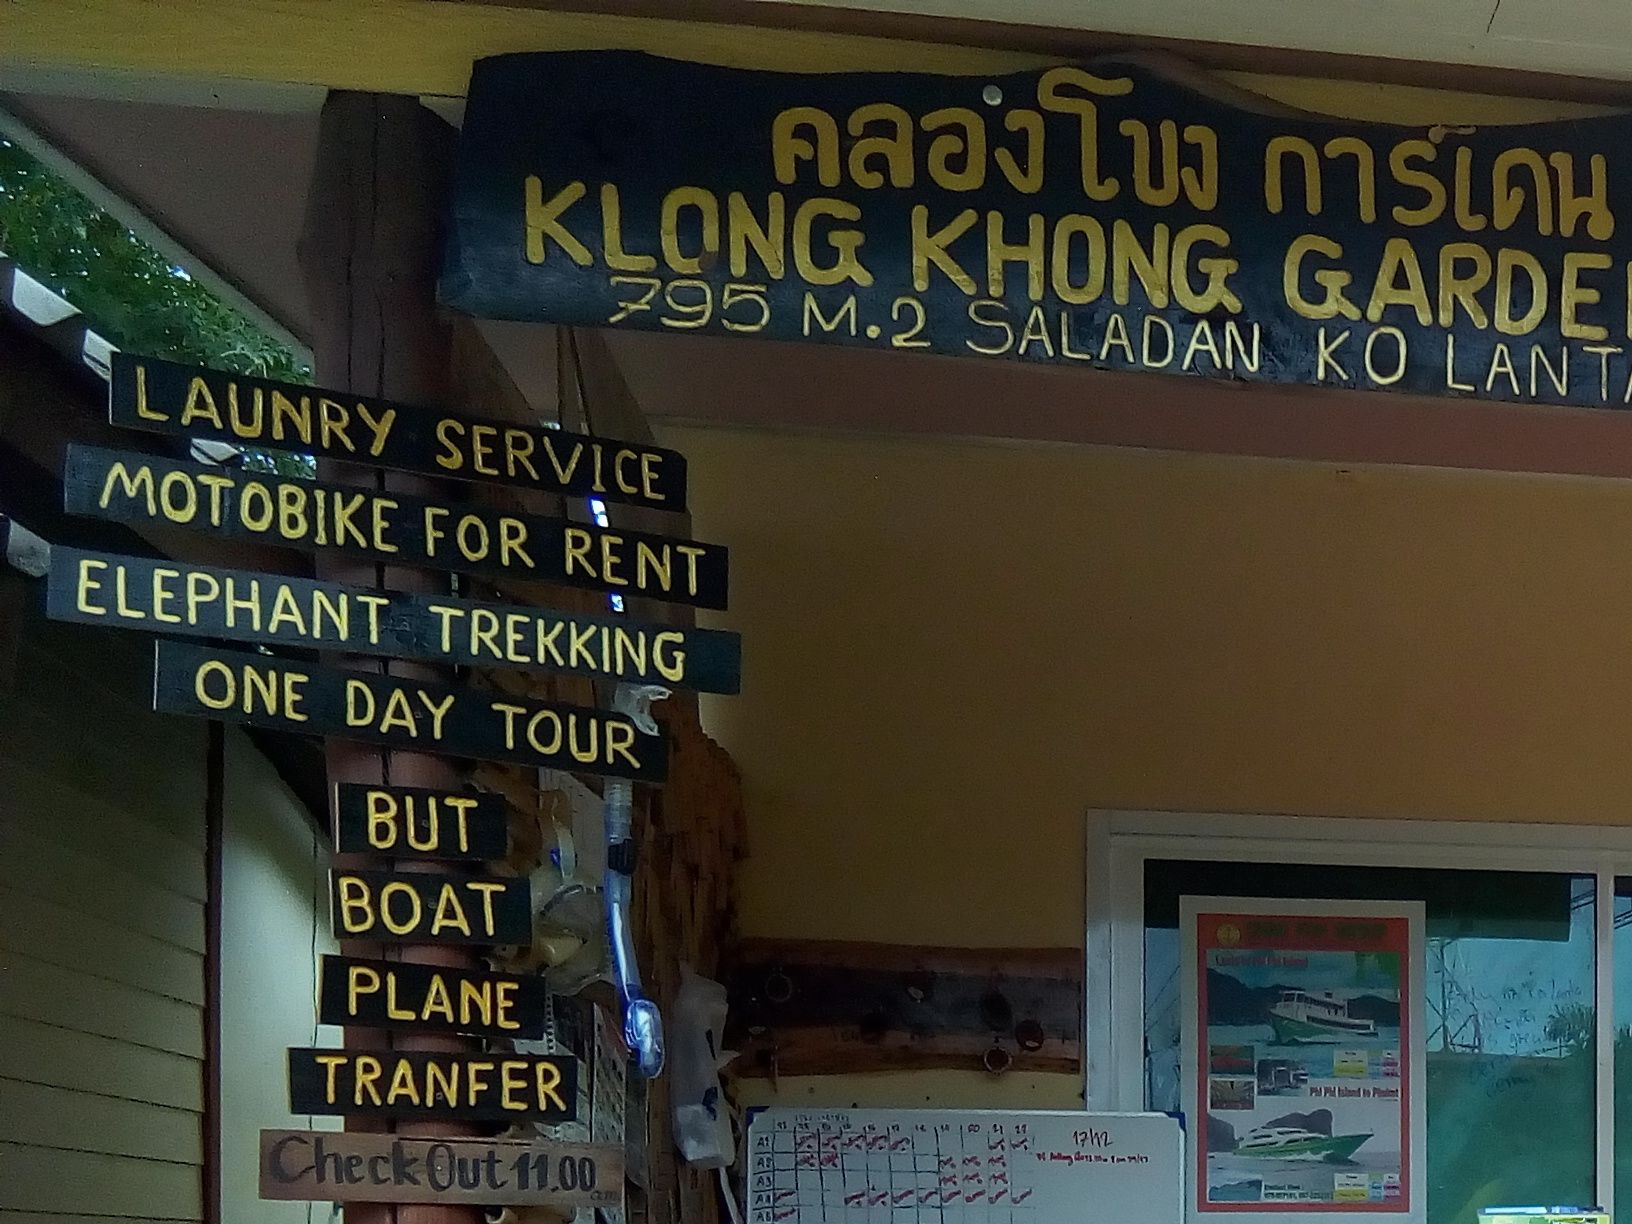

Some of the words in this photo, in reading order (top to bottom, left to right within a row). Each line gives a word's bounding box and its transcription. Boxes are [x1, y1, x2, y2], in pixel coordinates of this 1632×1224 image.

[523, 175, 874, 288] KLONG
[910, 205, 1243, 316] KHONG
[608, 275, 770, 331] 795
[802, 293, 931, 350] M.2
[965, 300, 1261, 373] SALADAN
[1316, 327, 1407, 386] KO
[135, 364, 396, 457] LAUNRY
[435, 418, 667, 500] SERVICE
[99, 461, 399, 553] MOTOBIKE
[424, 507, 535, 569] FOR
[564, 528, 707, 597] RENT
[76, 558, 389, 645] ELEPHANT
[428, 604, 687, 683] TREKKING
[194, 660, 310, 722] ONE
[346, 679, 455, 741] DAY
[491, 701, 641, 769] TOUR
[366, 790, 478, 853] BUT
[338, 876, 506, 937] BOAT
[348, 966, 520, 1031] PLANE
[315, 1054, 567, 1113] TRANFER
[269, 1136, 422, 1185] Check
[425, 1142, 509, 1193] Out
[509, 1152, 597, 1192] 11.00
